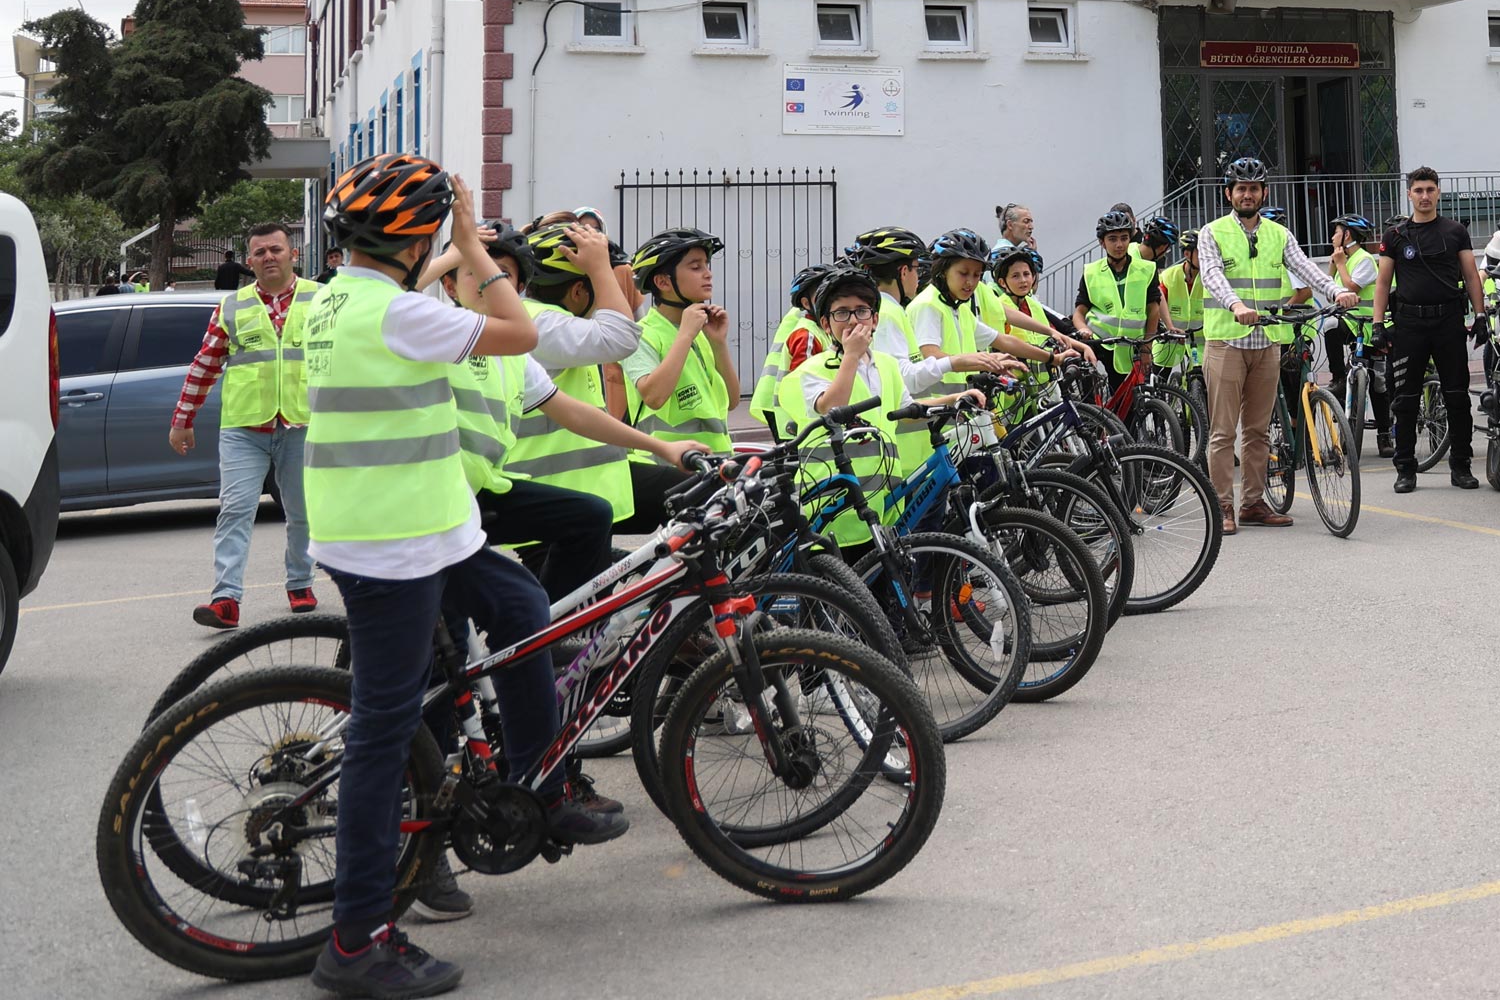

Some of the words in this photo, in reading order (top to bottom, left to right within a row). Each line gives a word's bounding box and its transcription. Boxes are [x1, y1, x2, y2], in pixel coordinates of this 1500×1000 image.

[1255, 45, 1269, 53] BU
[1270, 45, 1309, 54] OKULDA
[1210, 54, 1243, 63] BÜTÜN
[1245, 54, 1306, 64] ÖĞRENCİLER
[823, 110, 870, 118] Twinning
[541, 601, 673, 778] SALCANO
[113, 701, 219, 835] SALCANO
